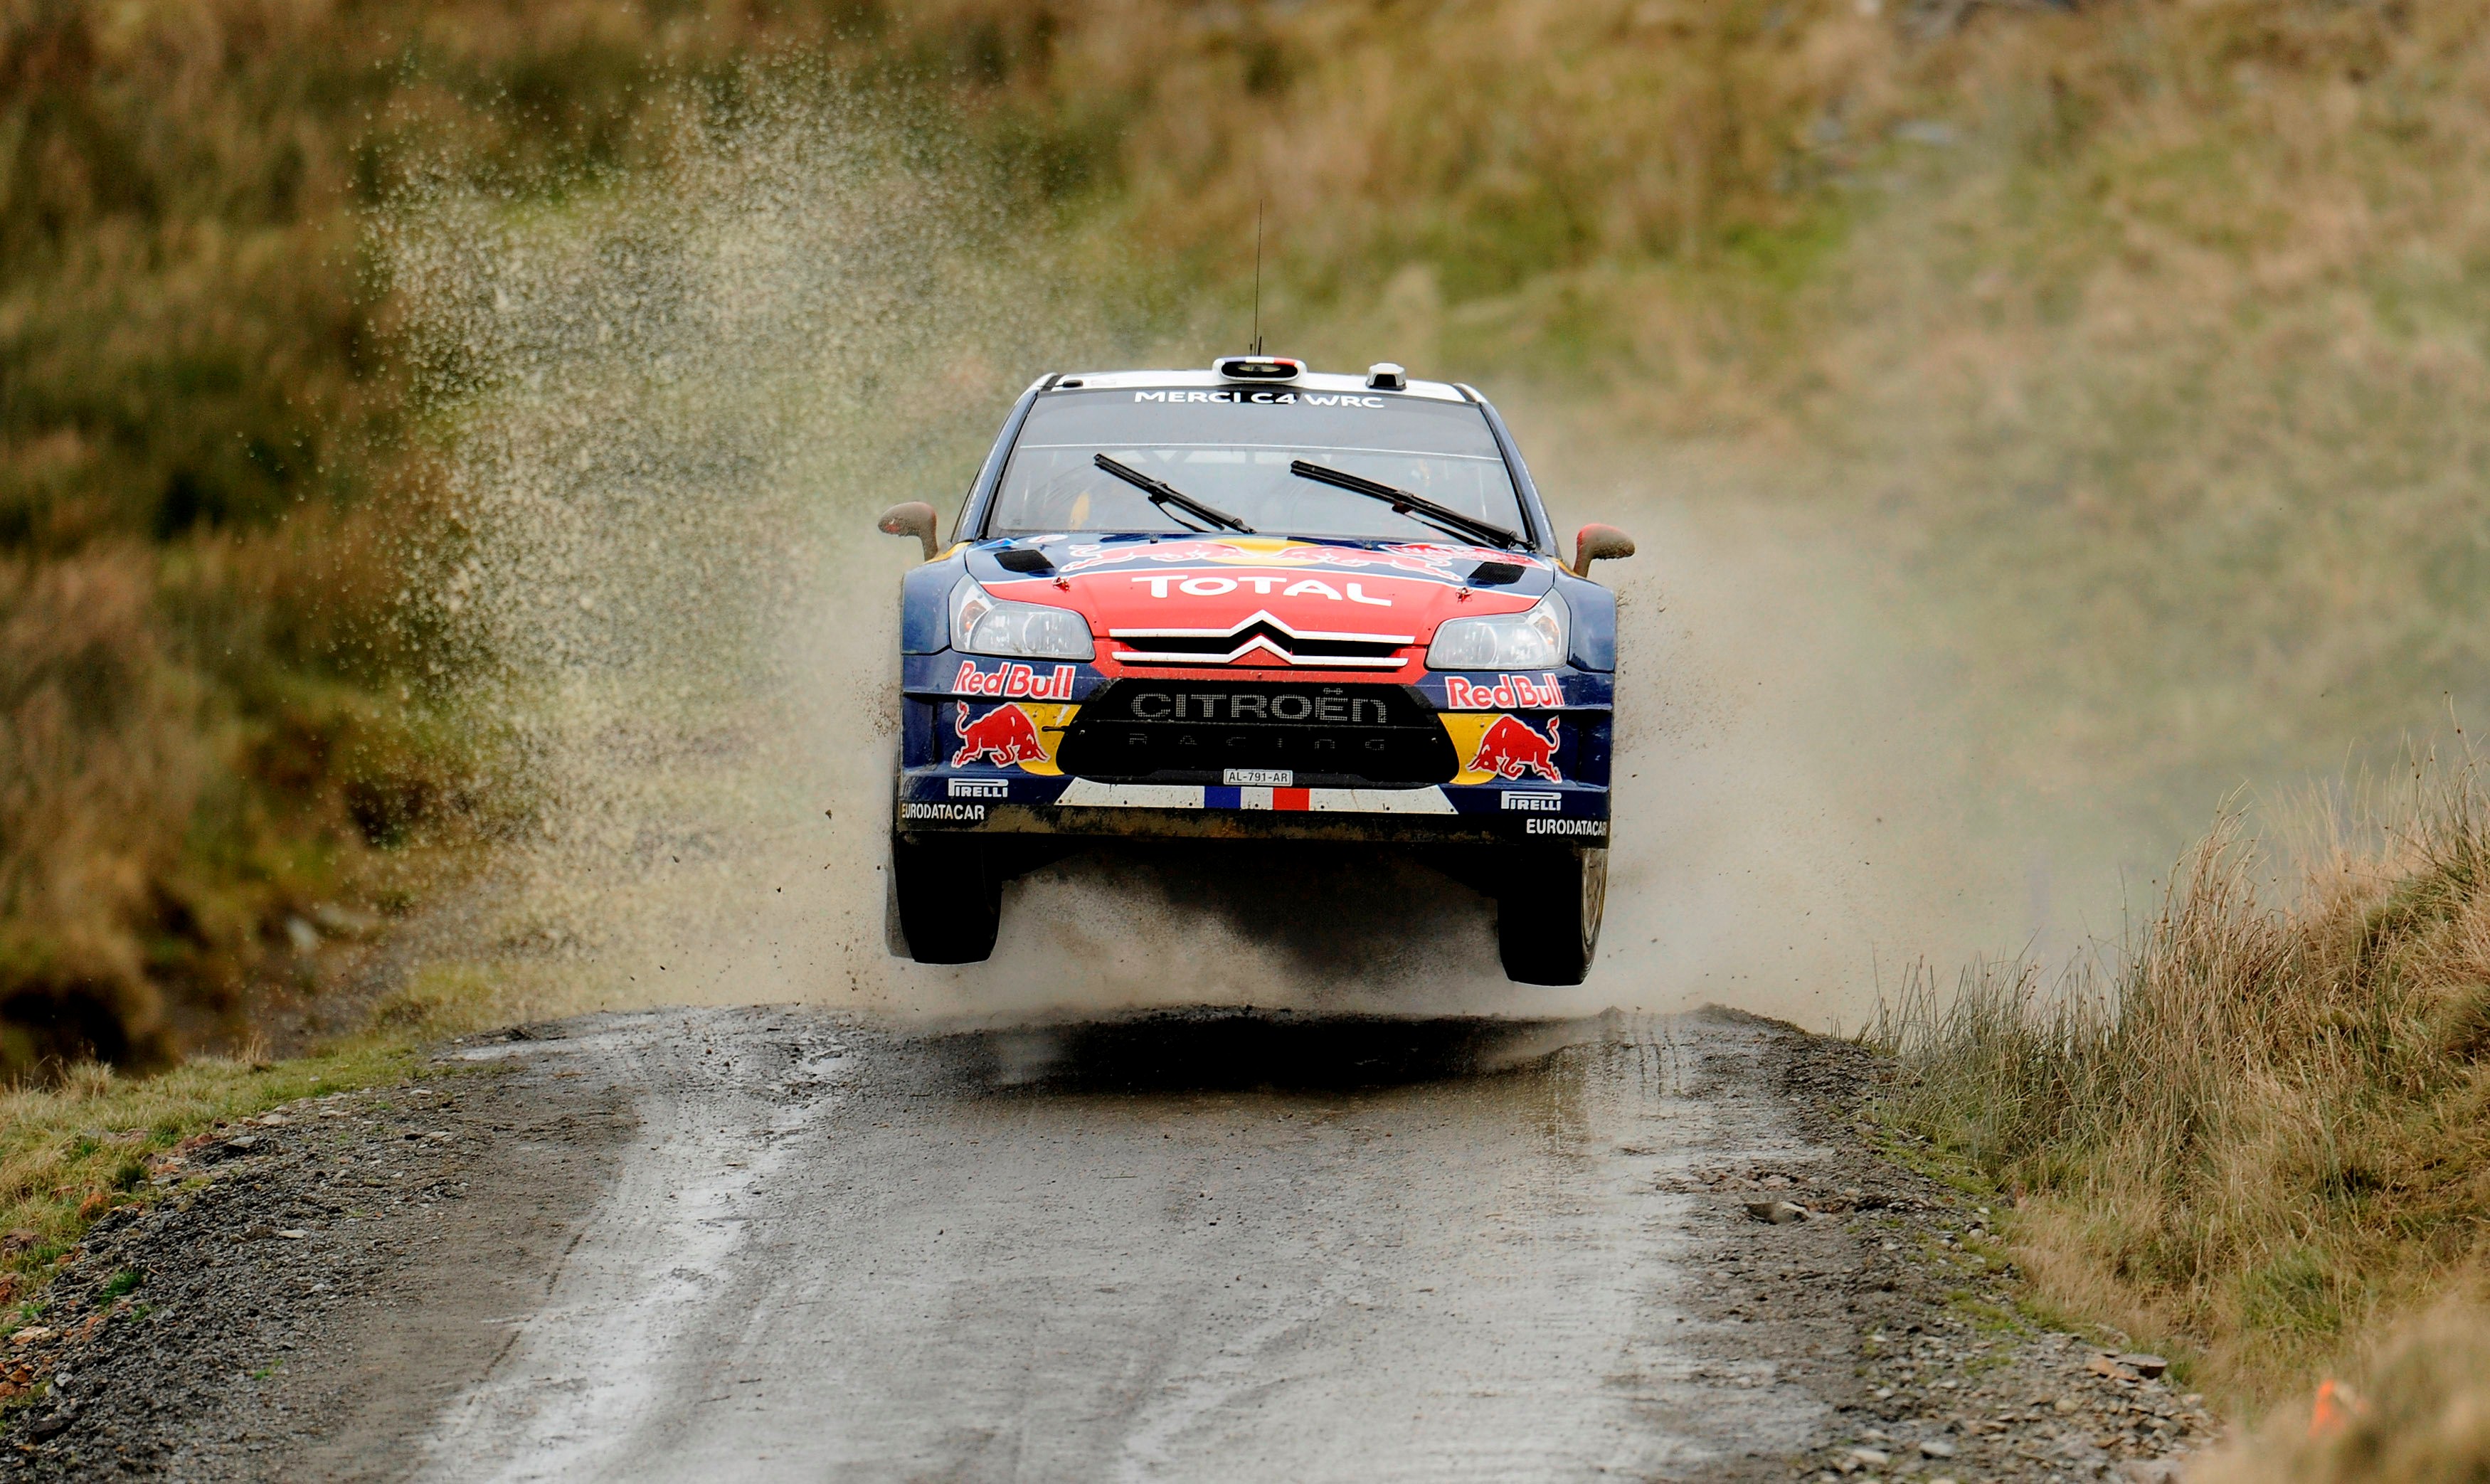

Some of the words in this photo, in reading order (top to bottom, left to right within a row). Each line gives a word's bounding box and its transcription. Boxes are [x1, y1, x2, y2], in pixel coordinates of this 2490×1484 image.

[1134, 391, 1241, 403] MERCI
[1251, 392, 1296, 404] C4
[1304, 394, 1384, 408] WRC
[1131, 575, 1392, 607] TOTAL
[953, 661, 1010, 696] Red
[1004, 664, 1076, 700] Bull
[1445, 674, 1517, 709] Red
[1511, 673, 1564, 709] Bull
[1228, 772, 1288, 783] AL-791-AR
[948, 778, 1009, 797] PIRELLI
[1501, 790, 1562, 811] PIRELLI
[901, 803, 985, 820] EURODATACAR
[1526, 819, 1607, 836] EURODATACAR
